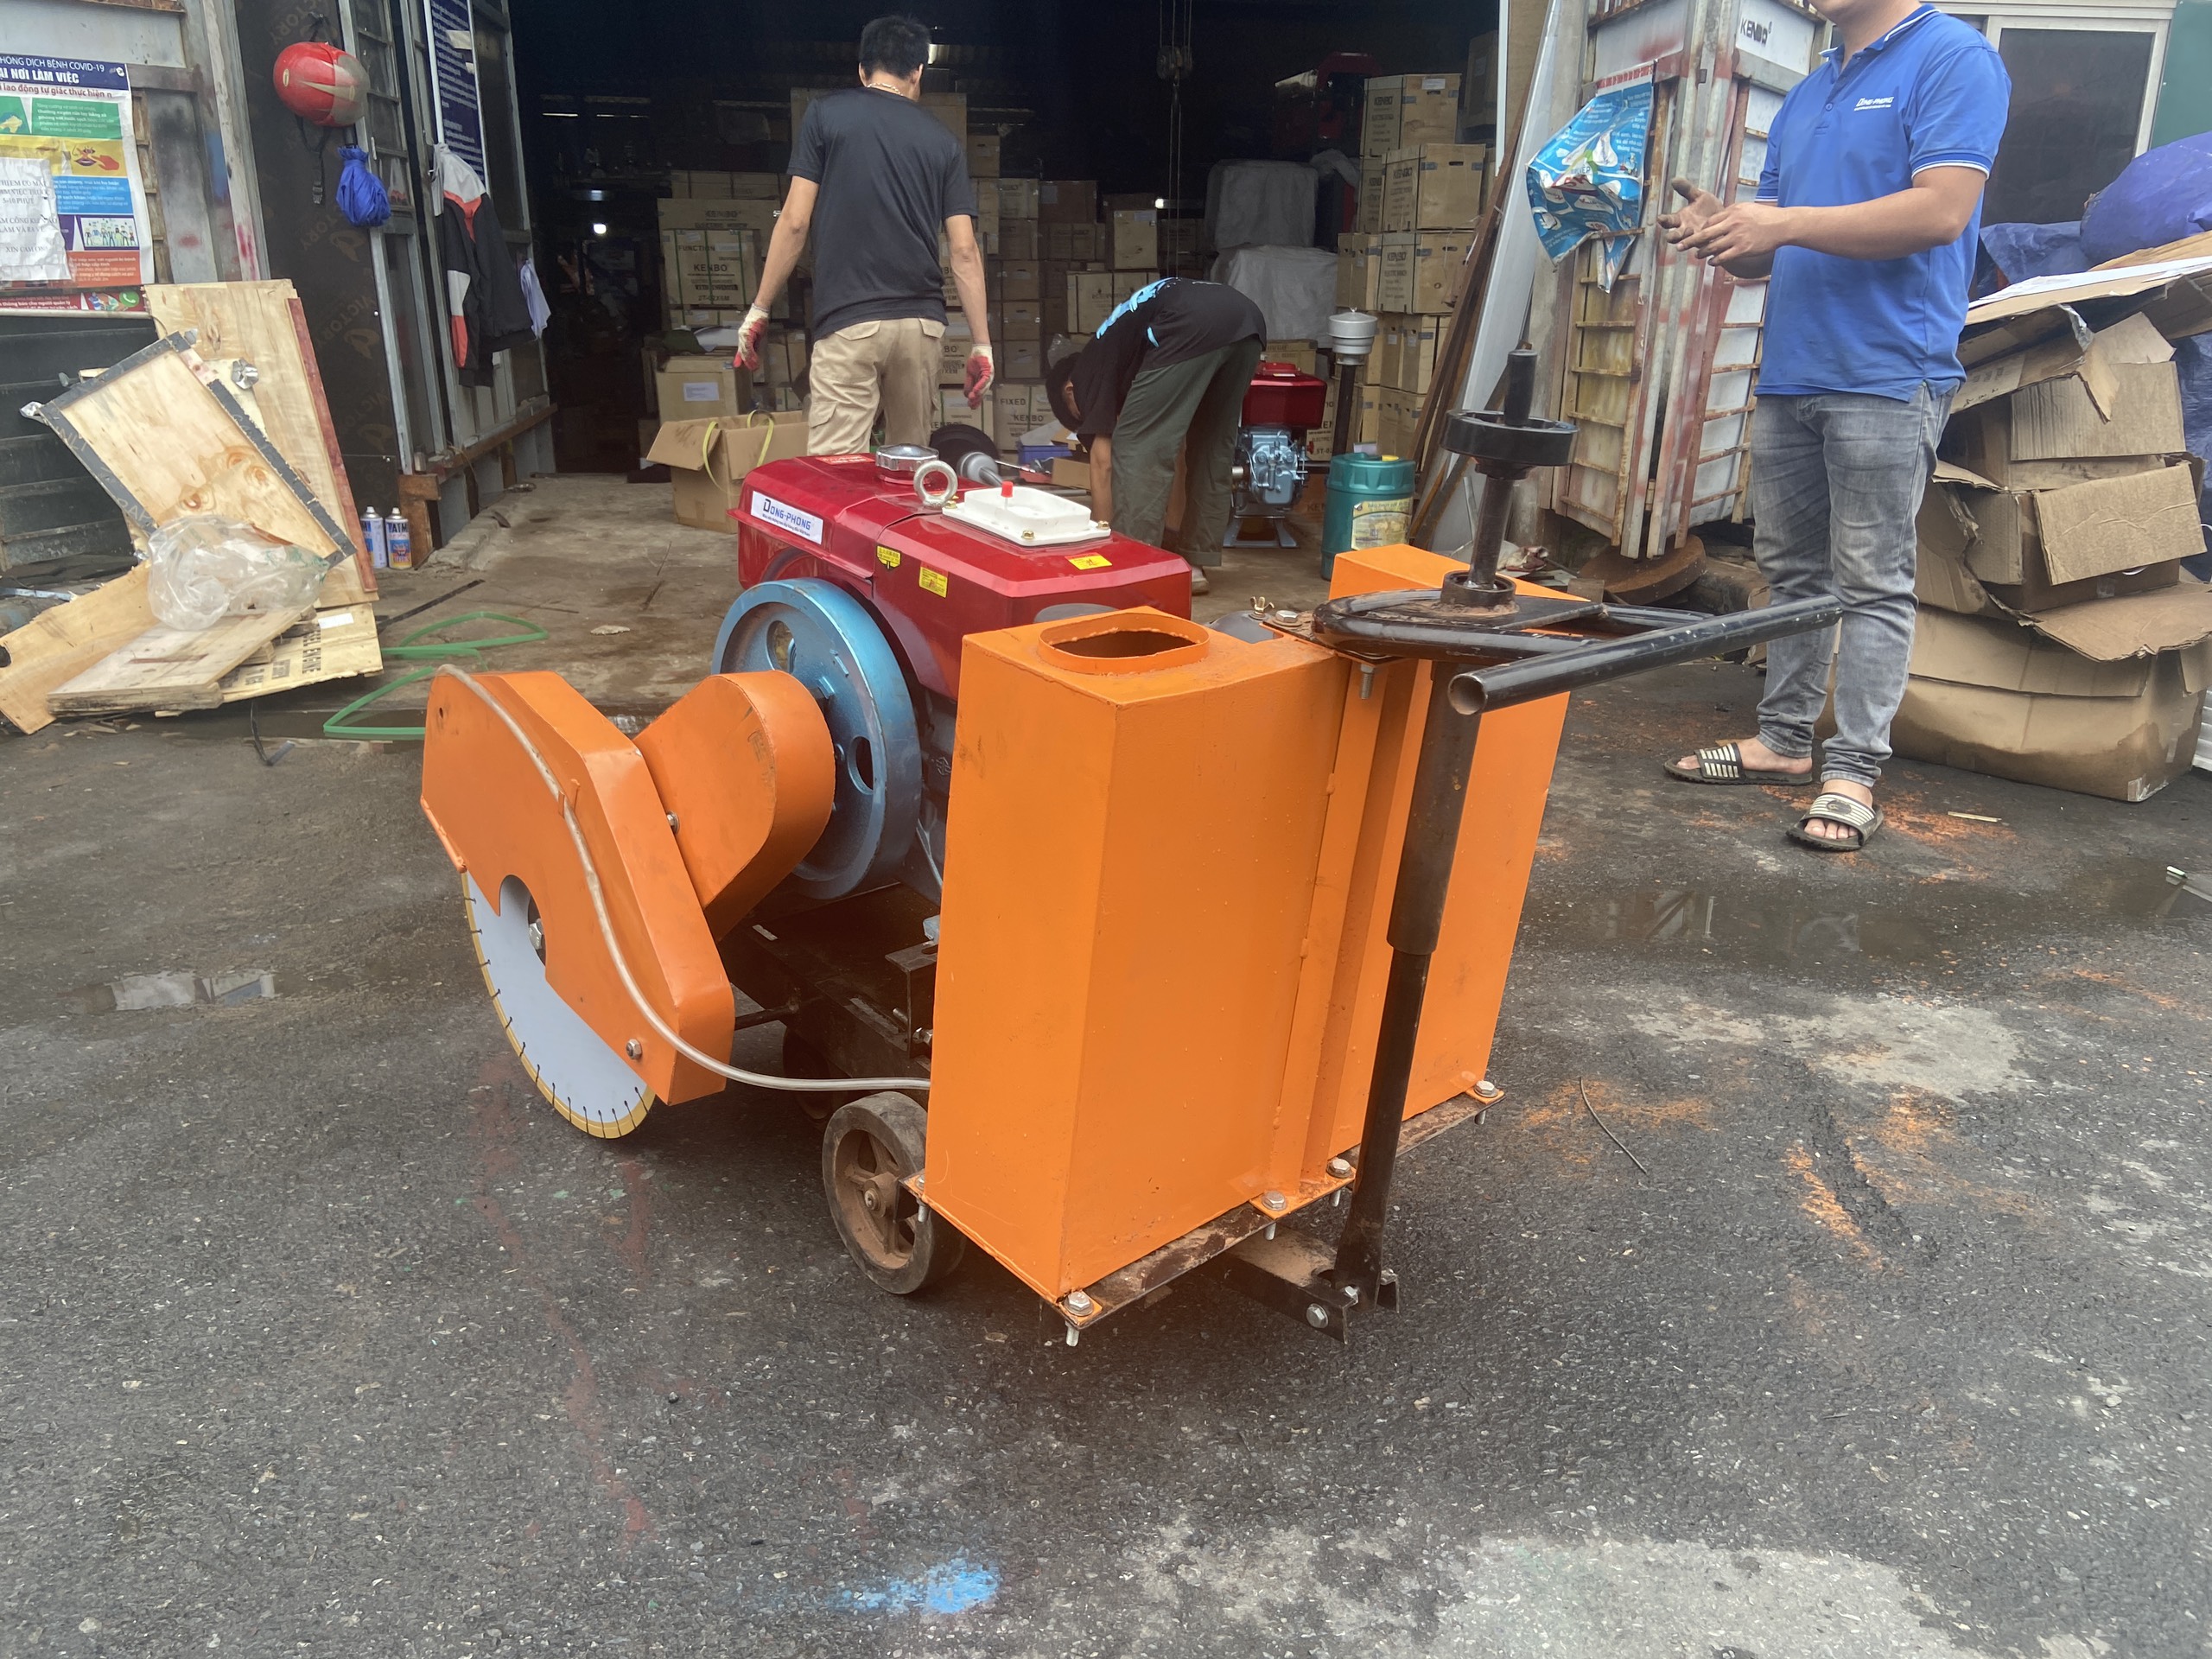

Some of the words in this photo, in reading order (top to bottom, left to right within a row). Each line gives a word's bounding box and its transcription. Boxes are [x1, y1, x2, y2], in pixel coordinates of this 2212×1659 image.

[26, 57, 45, 67] DỊCH
[47, 58, 67, 69] BỆNH
[69, 61, 105, 72] COVID-19
[0, 68, 9, 79] ẠI
[10, 67, 29, 79] NƠI
[32, 68, 54, 81] LÀM
[55, 71, 79, 85] VIỆC
[18, 84, 39, 95] động
[1306, 504, 1325, 512] KEN
